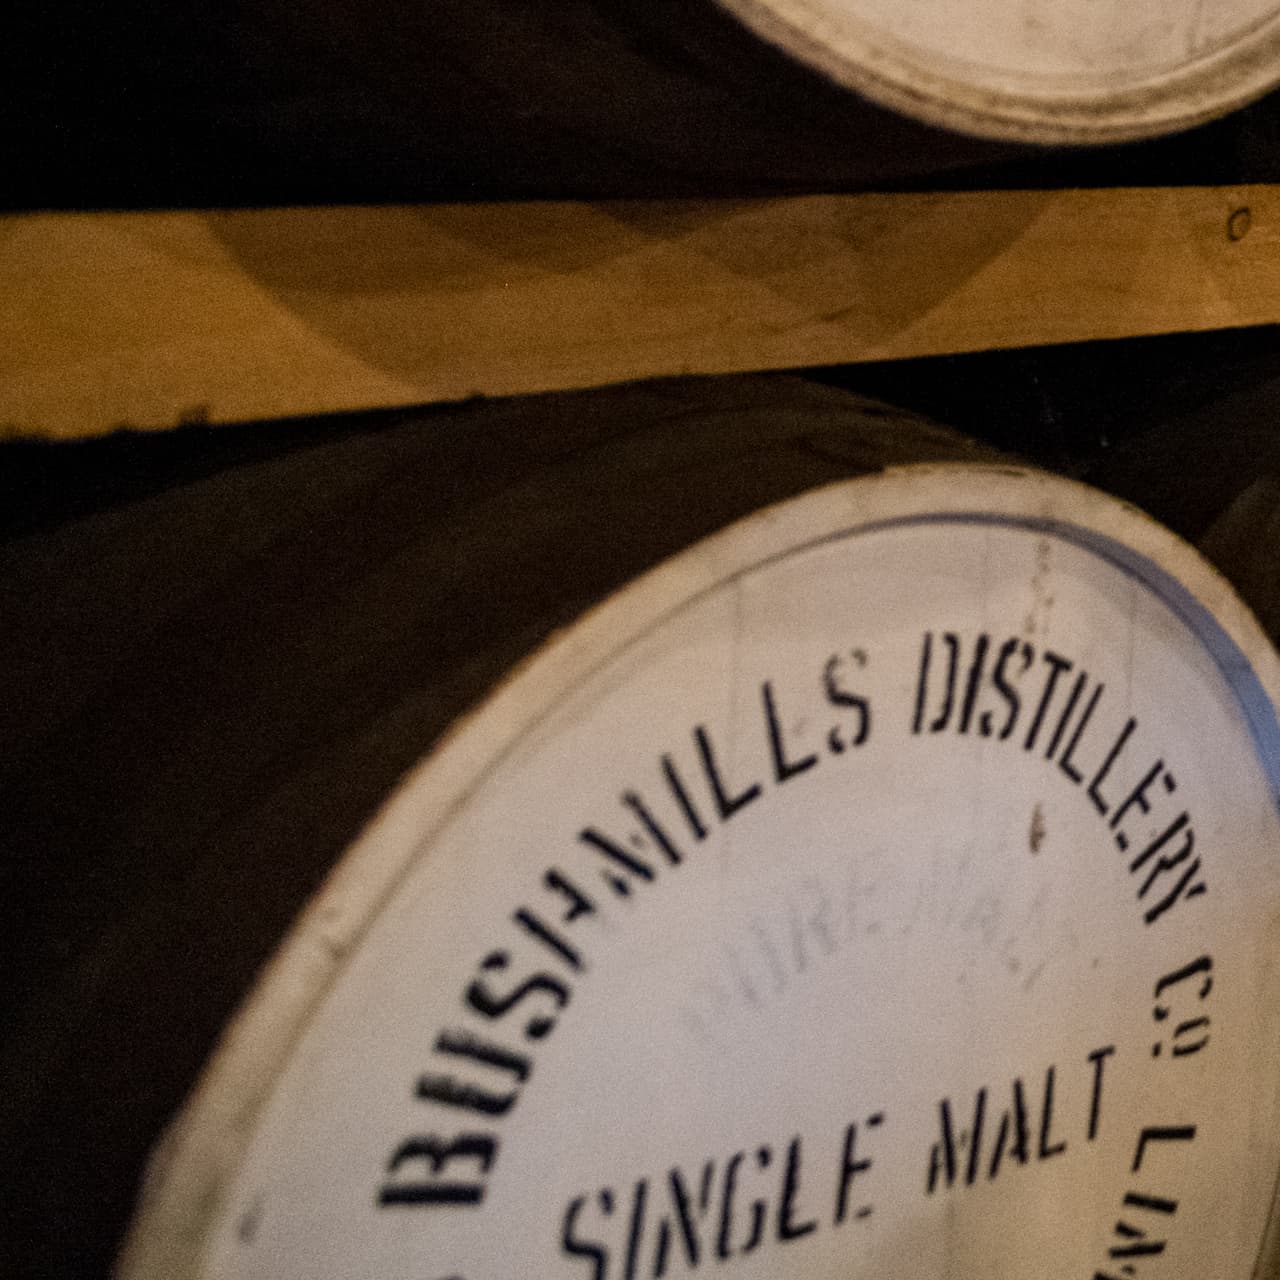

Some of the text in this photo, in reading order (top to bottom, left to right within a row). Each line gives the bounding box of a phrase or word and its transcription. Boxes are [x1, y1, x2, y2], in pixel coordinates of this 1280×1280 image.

[377, 647, 872, 1208] BUSHMILLS
[912, 630, 1209, 926] DISTILLERY
[559, 1045, 1118, 1280] SINGLE MALT
